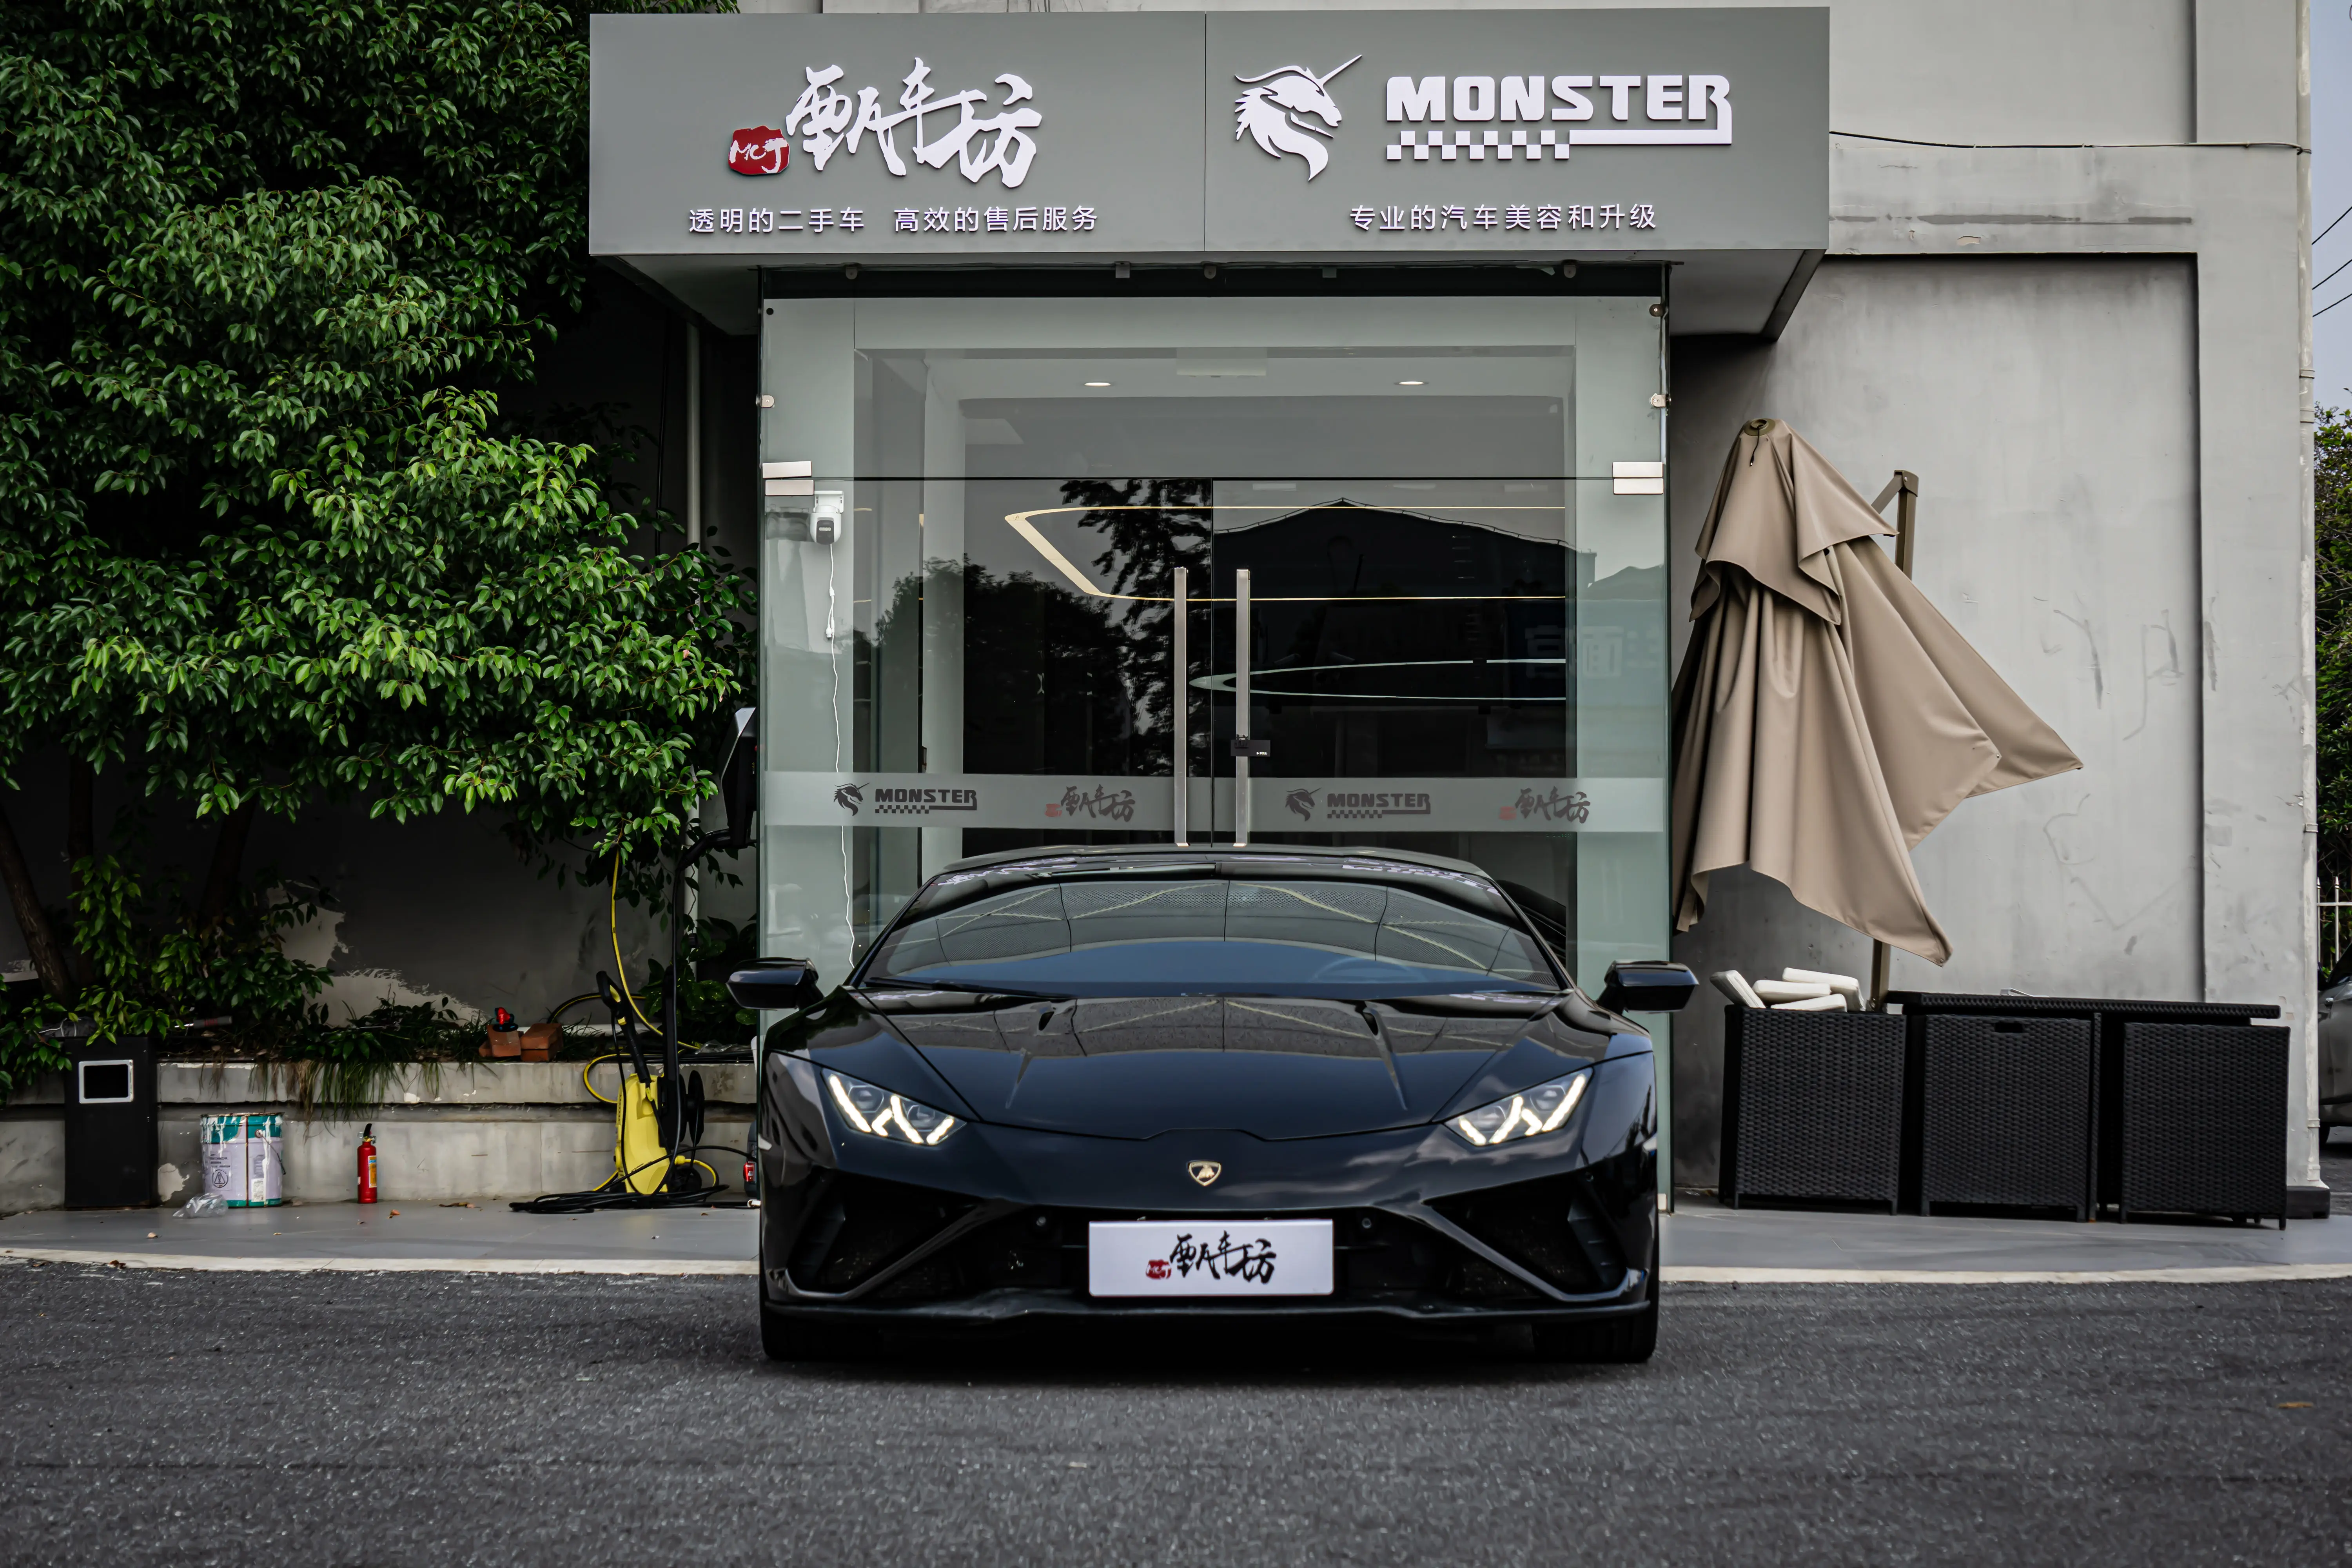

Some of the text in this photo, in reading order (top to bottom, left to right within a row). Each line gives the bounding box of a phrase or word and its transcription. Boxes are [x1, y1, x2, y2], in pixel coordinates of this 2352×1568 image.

[1387, 75, 1732, 144] MONSTER
[689, 205, 1098, 233] 透明的二手车 高效的售后服务
[1350, 203, 1657, 230] 专业的汽车美容和升级
[875, 788, 977, 810] MONSTER
[1327, 793, 1431, 814] MONSTER
